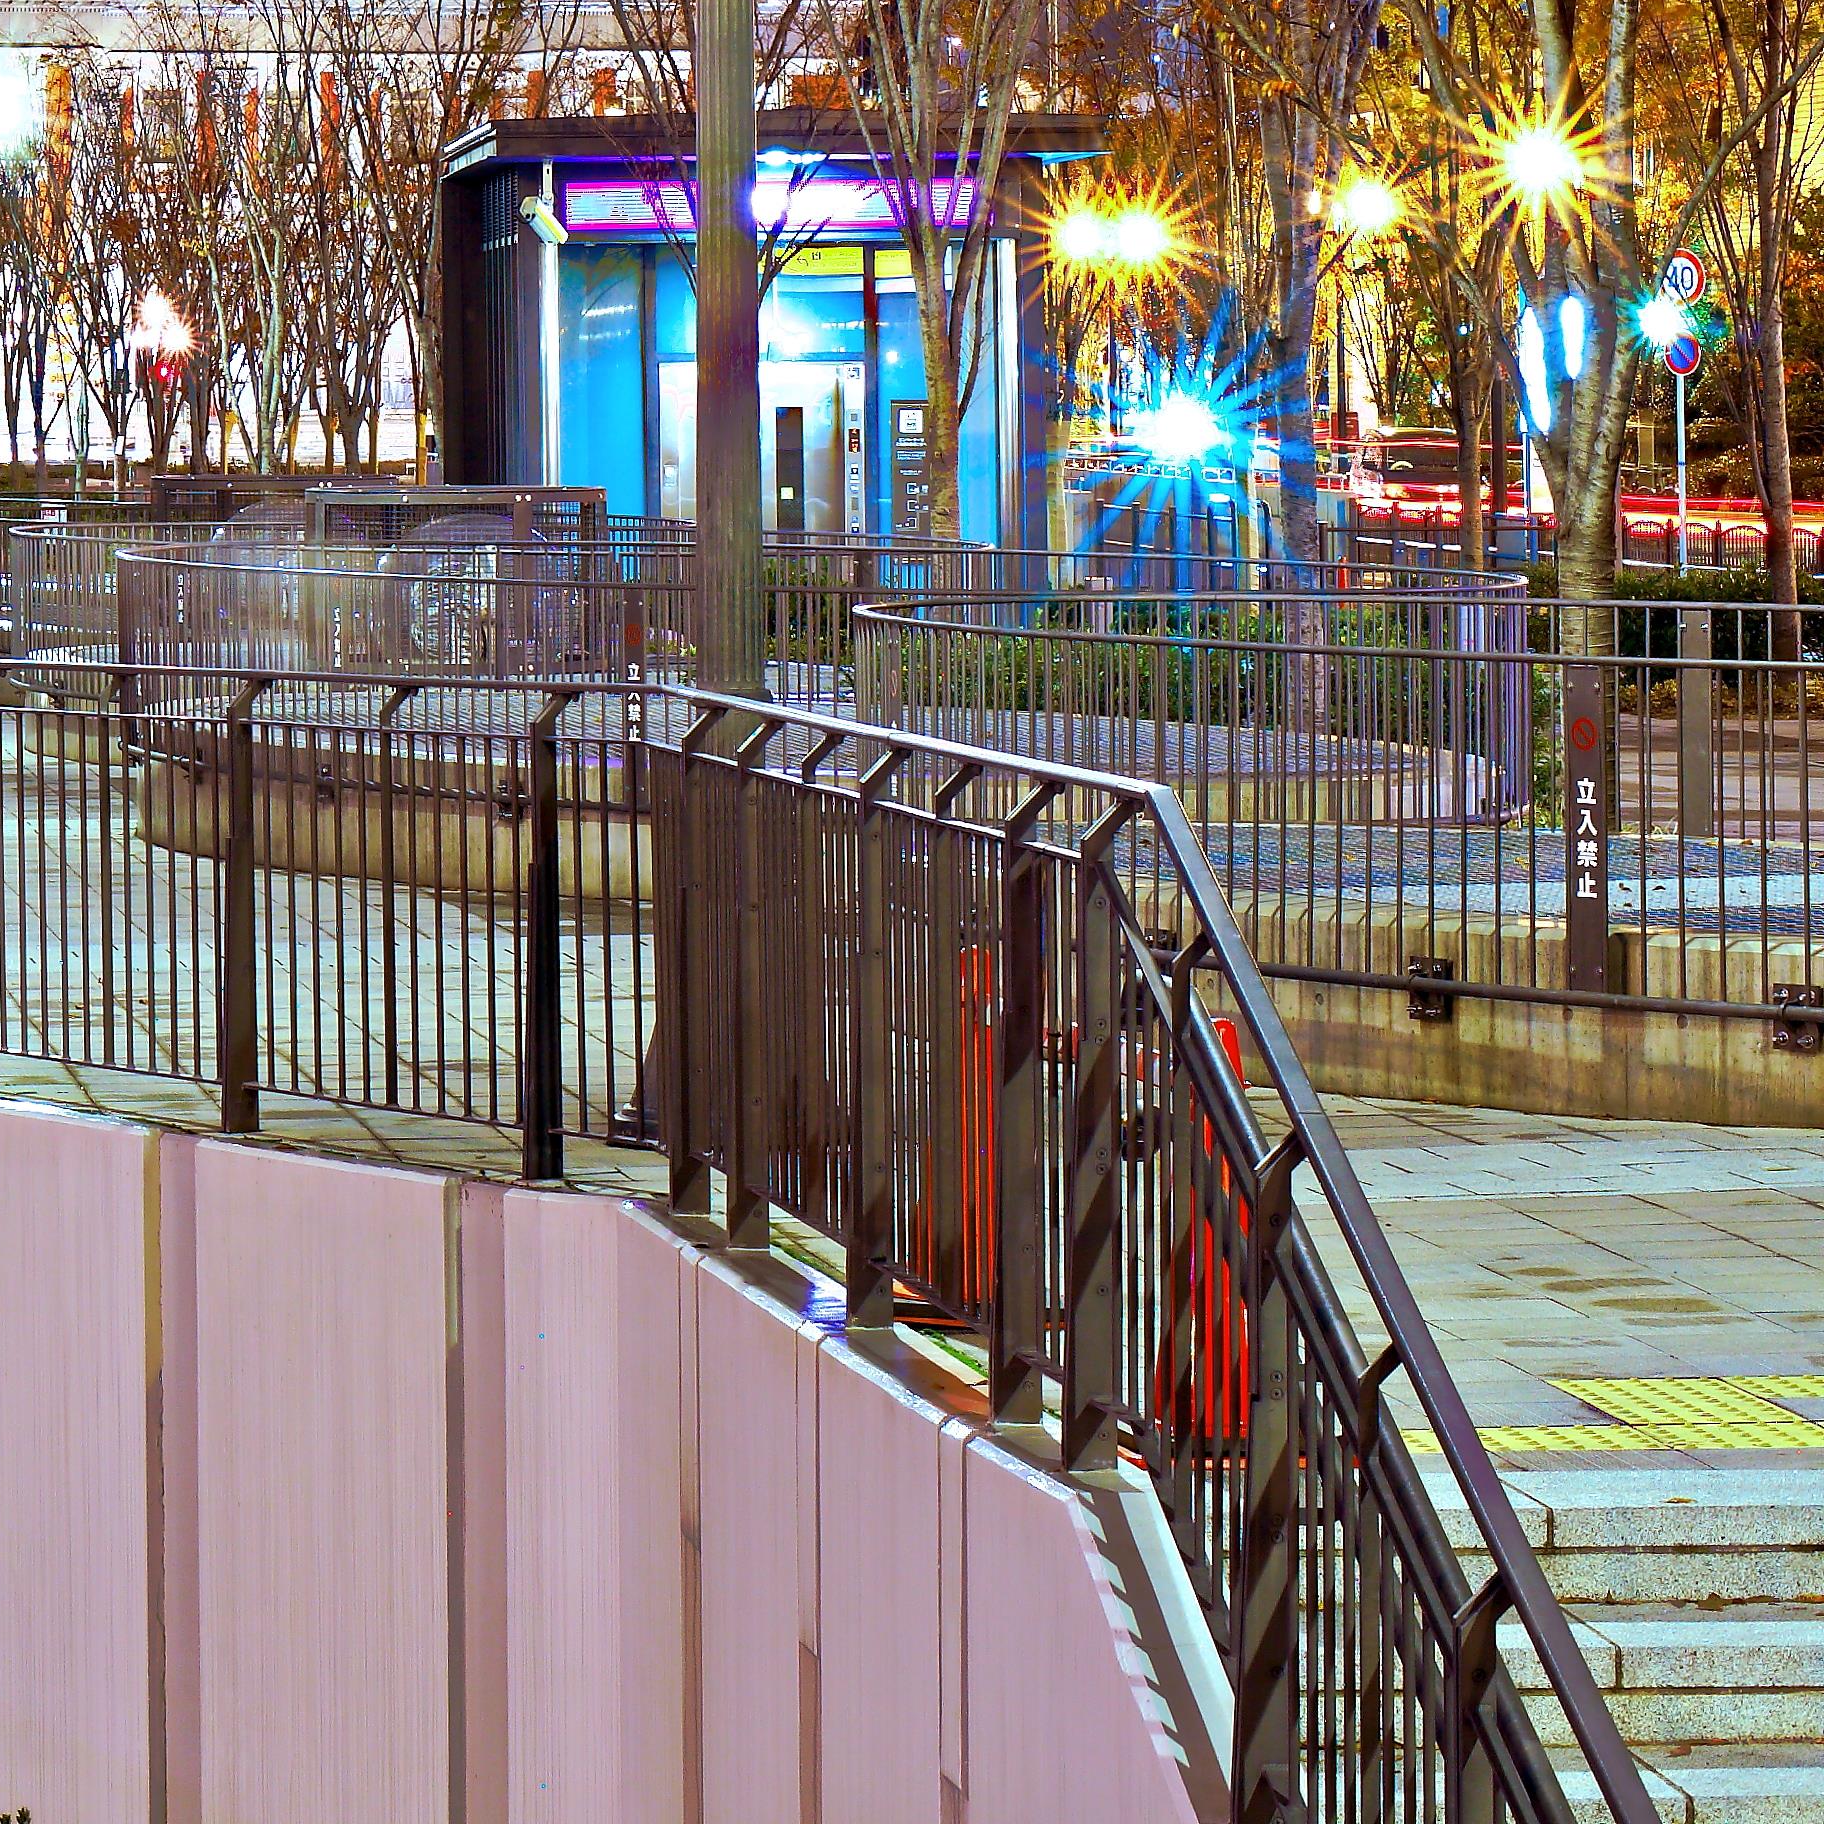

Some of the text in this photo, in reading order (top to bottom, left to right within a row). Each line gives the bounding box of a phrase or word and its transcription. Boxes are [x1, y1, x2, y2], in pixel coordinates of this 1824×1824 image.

[1668, 266, 1693, 290] 40
[1576, 777, 1598, 898] 立入禁止
